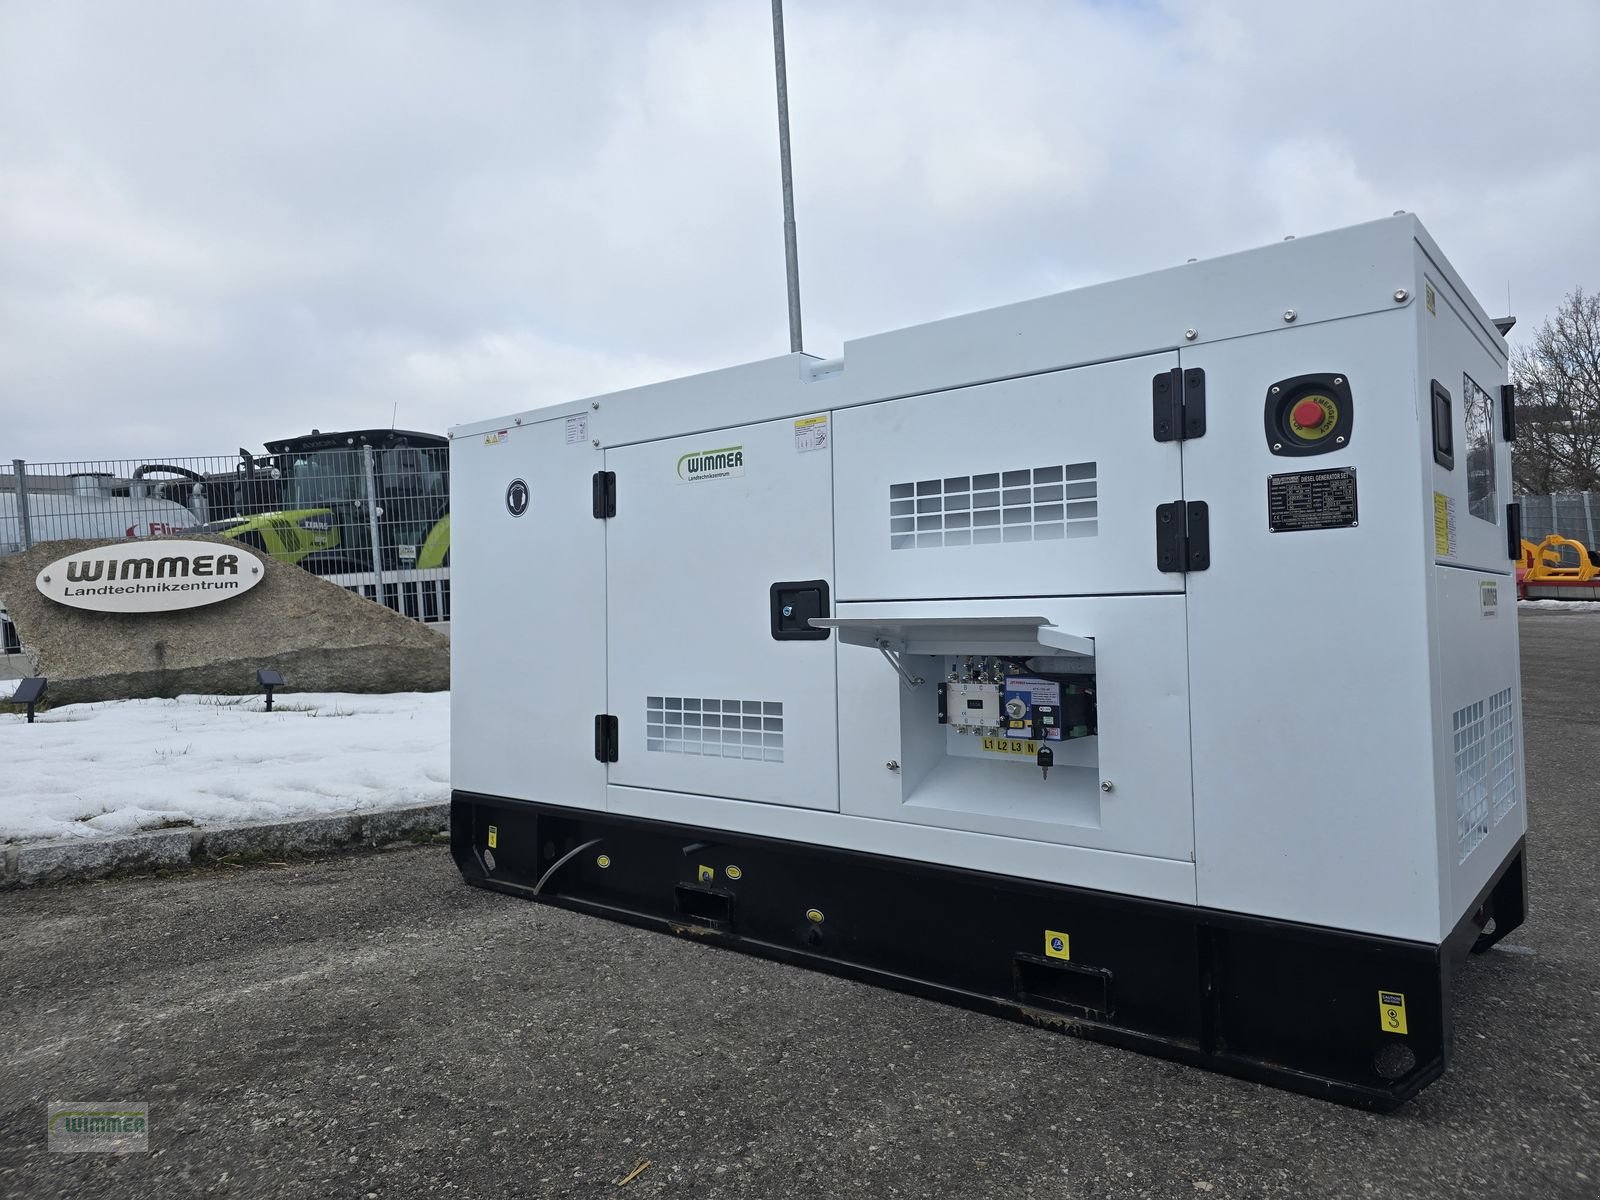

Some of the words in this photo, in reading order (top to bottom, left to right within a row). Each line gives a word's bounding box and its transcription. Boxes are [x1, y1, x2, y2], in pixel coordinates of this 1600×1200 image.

[1312, 397, 1335, 434] EMERGENCY
[687, 451, 743, 474] WIMMER
[687, 472, 730, 482] Landtechnikzentrum
[1300, 475, 1315, 483] DIESEL
[1315, 473, 1340, 482] GENERATOR
[147, 522, 183, 537] Fli
[66, 554, 239, 583] WIMMER
[64, 580, 239, 597] Landtechnikzentrum
[984, 739, 994, 749] L1
[997, 741, 1008, 751] L2
[1011, 742, 1022, 752] L3
[1027, 743, 1034, 753] N
